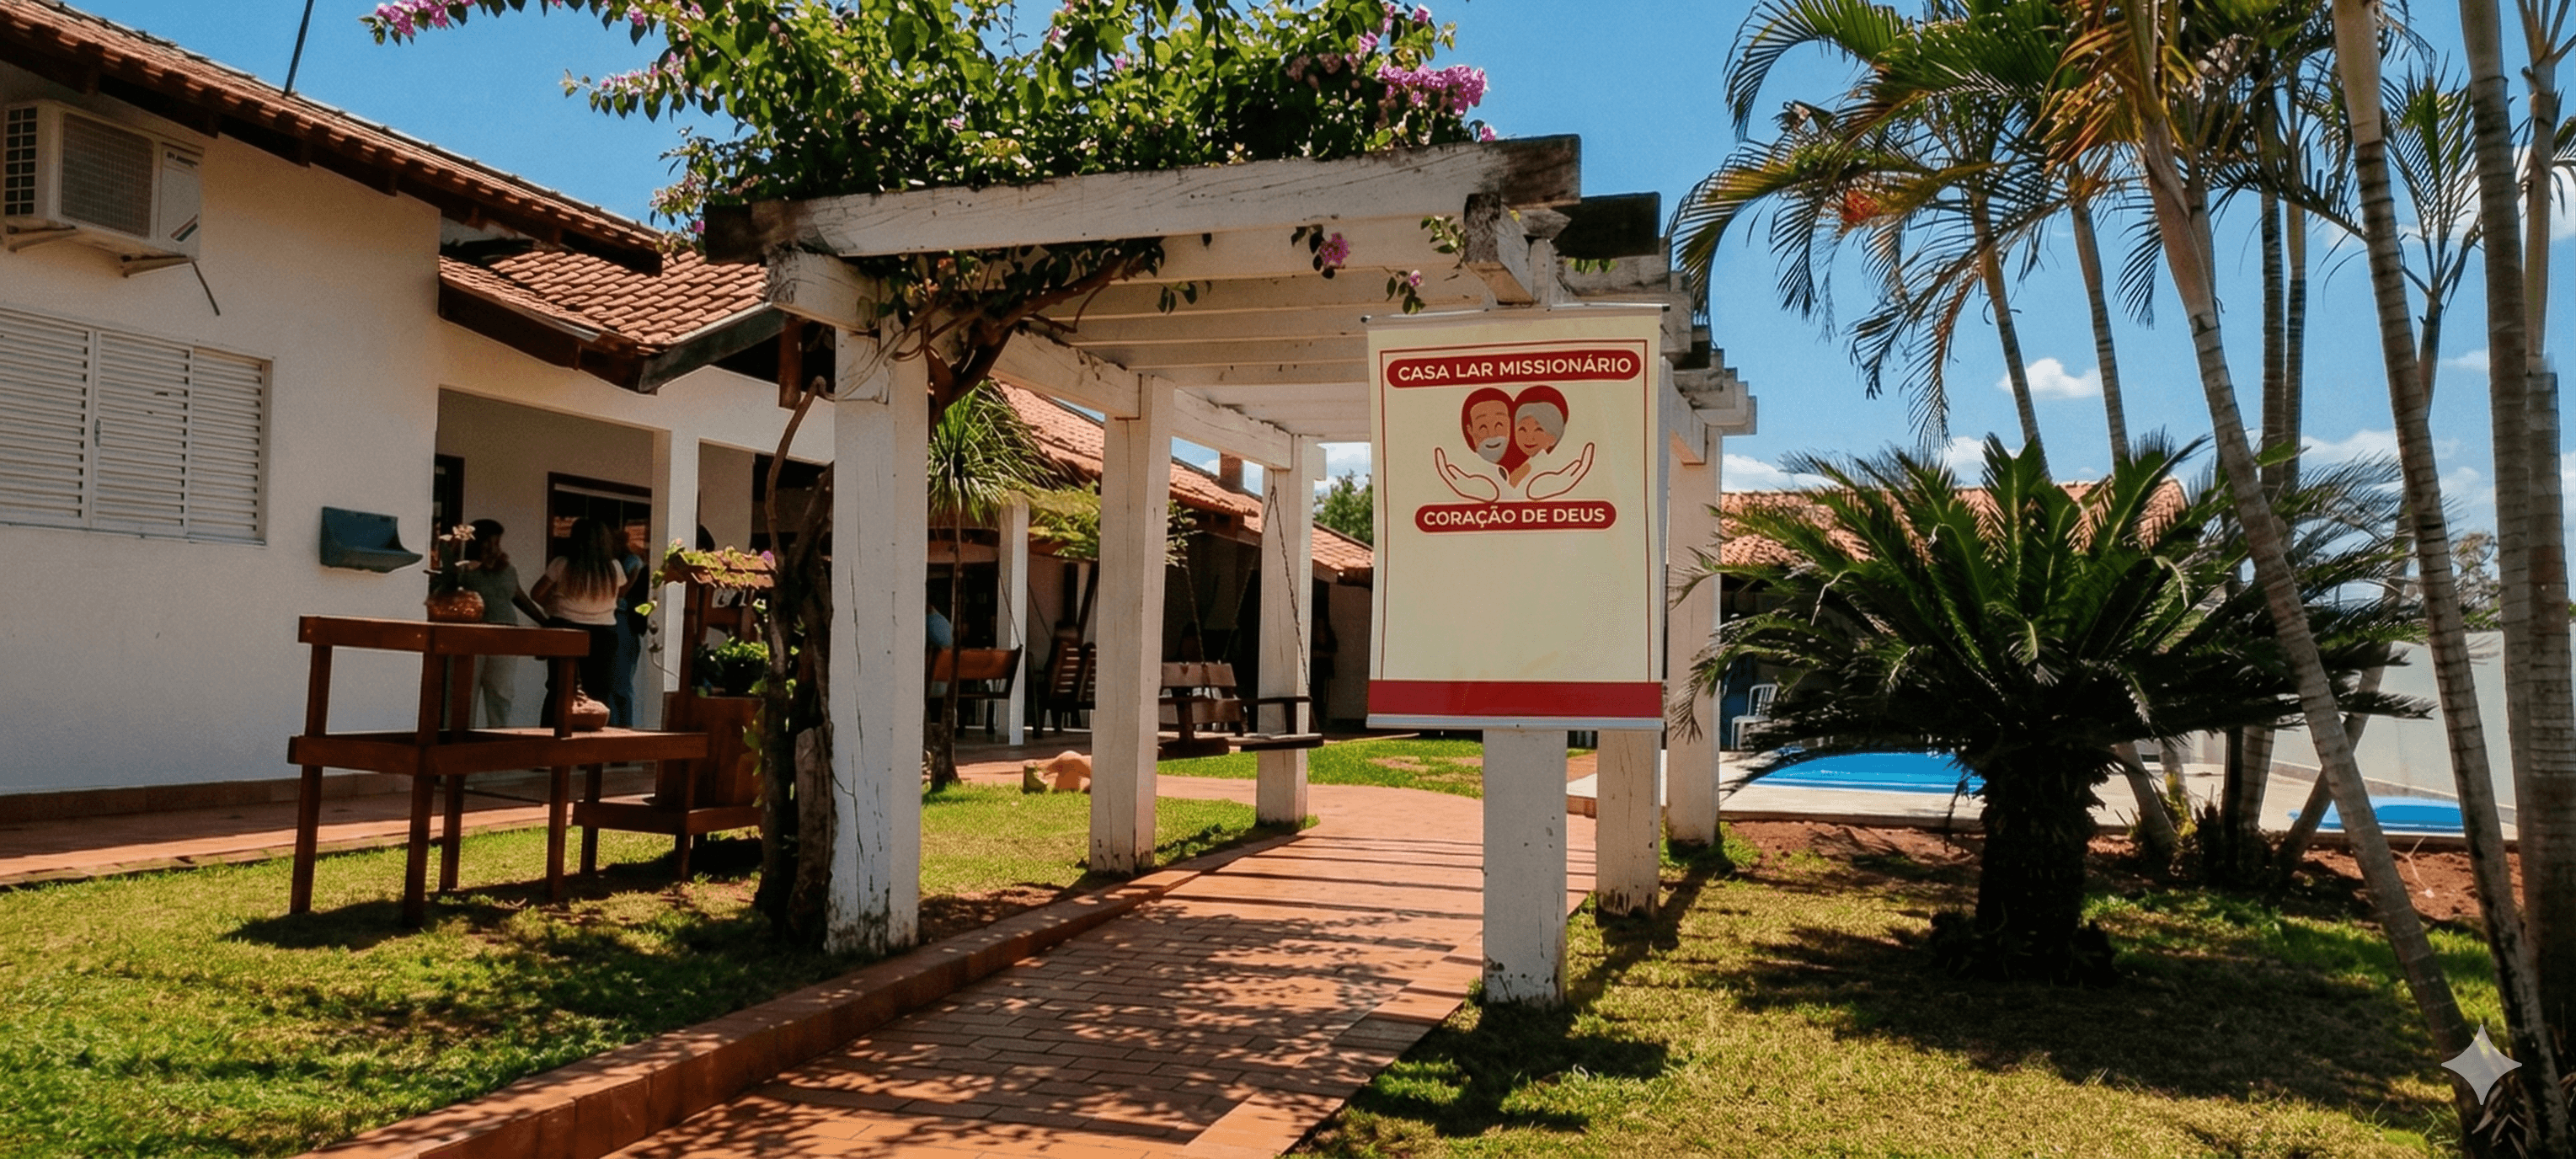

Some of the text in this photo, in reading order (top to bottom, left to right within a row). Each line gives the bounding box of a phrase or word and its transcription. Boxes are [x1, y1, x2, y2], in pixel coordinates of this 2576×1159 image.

[1398, 354, 1632, 382] CASA LAR MISSIONÁRIO
[1424, 505, 1606, 528] CORAÇÃO DE DEUS
